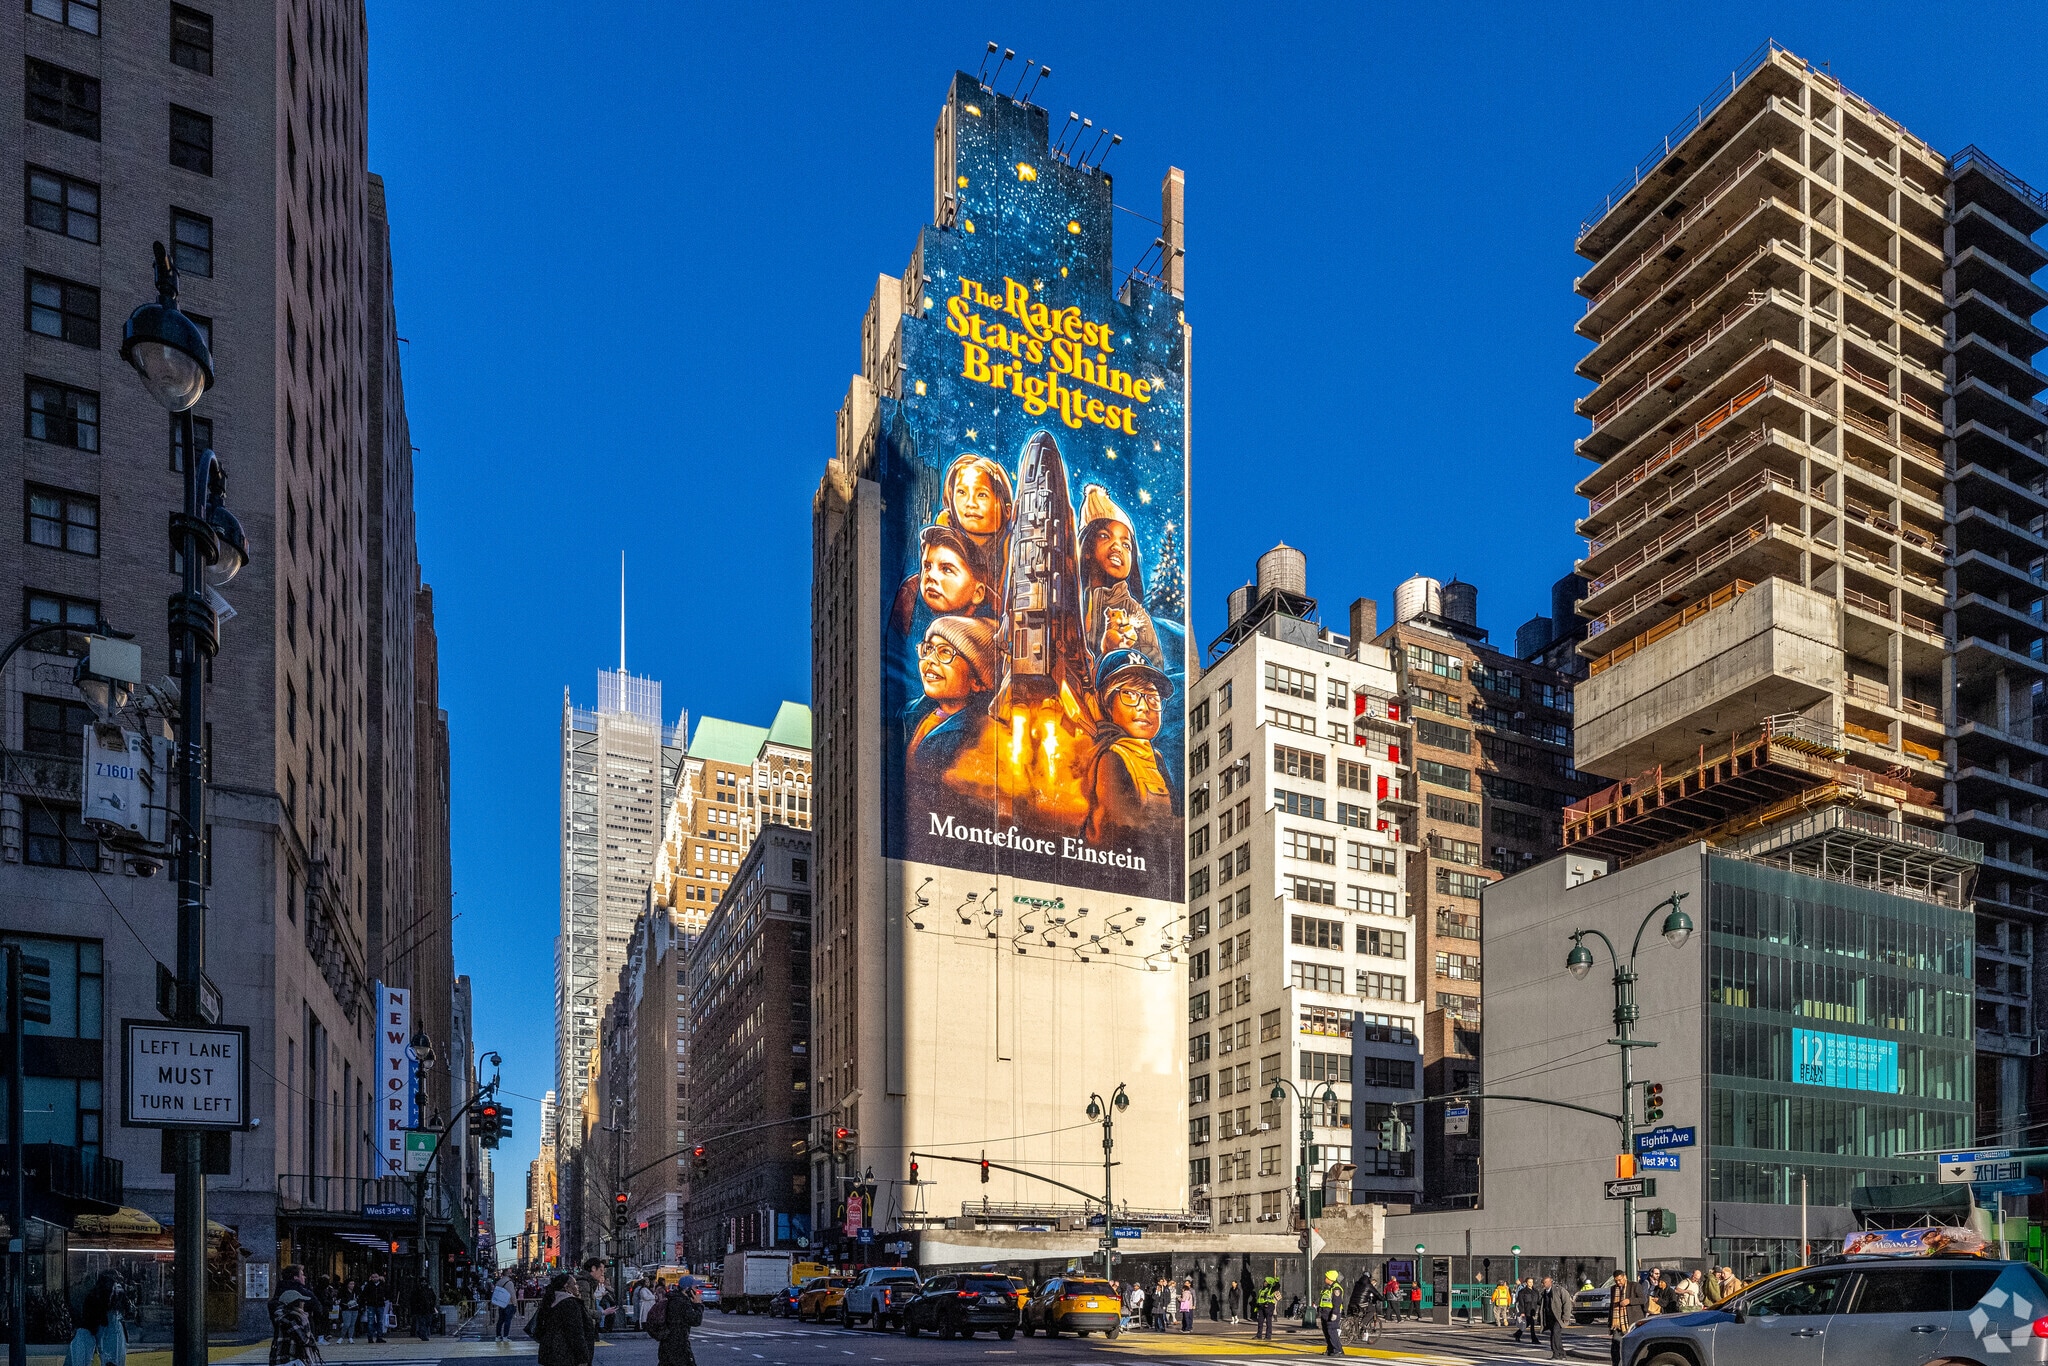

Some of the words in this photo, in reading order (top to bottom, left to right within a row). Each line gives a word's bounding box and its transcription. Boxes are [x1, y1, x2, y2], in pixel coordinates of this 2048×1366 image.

[958, 276, 1003, 310] The
[1003, 275, 1115, 353] Rarest
[946, 296, 1044, 364] Stars
[1050, 338, 1151, 404] Shine
[961, 341, 1138, 435] Brightest
[928, 812, 1056, 856] Montefiore
[1061, 837, 1147, 872] Einstein
[387, 992, 405, 1044] NEW
[140, 1039, 180, 1056] LEFT
[189, 1042, 232, 1058] LANE
[1800, 1036, 1823, 1066] 12
[158, 1066, 214, 1085] MUST
[1800, 1063, 1824, 1075] PENN
[140, 1094, 184, 1110] TURN
[193, 1097, 232, 1112] LEFT
[388, 1058, 403, 1171] YORKER
[1641, 1134, 1669, 1148] Eighth
[1671, 1133, 1689, 1143] Ave
[1657, 1157, 1669, 1166] 34th
[1669, 1157, 1677, 1167] St
[366, 1207, 386, 1215] West
[387, 1207, 400, 1215] 34th
[402, 1207, 410, 1215] St
[1875, 1241, 1908, 1249] MOANA
[1909, 1240, 1918, 1248] 2
